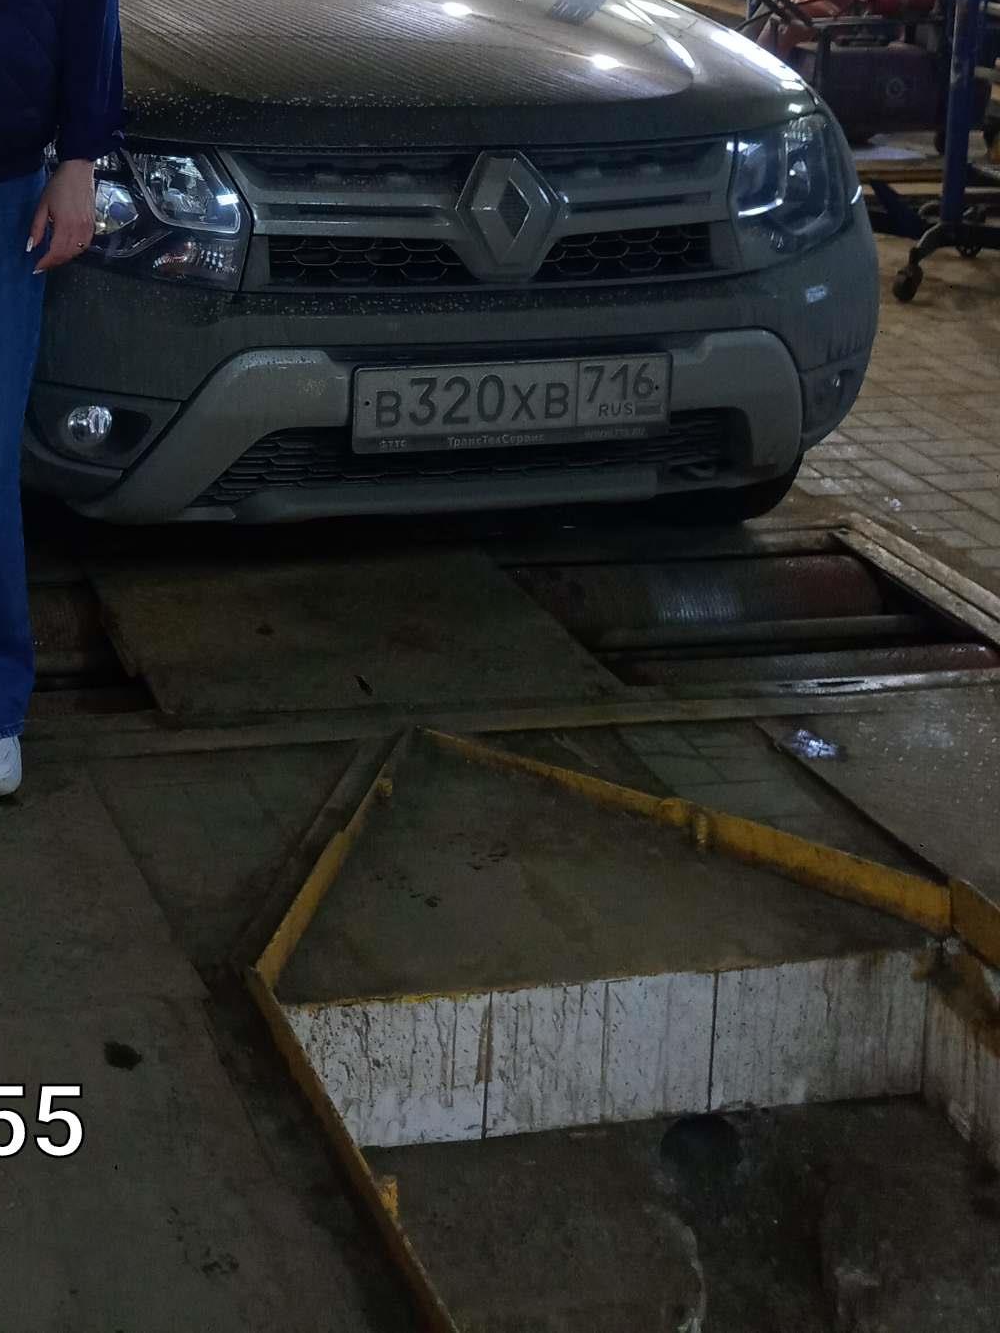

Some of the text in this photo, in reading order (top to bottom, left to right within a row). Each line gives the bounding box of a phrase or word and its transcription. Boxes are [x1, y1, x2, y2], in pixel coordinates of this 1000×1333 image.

[375, 363, 654, 429] В320ХВ 716
[598, 401, 634, 418] RUS
